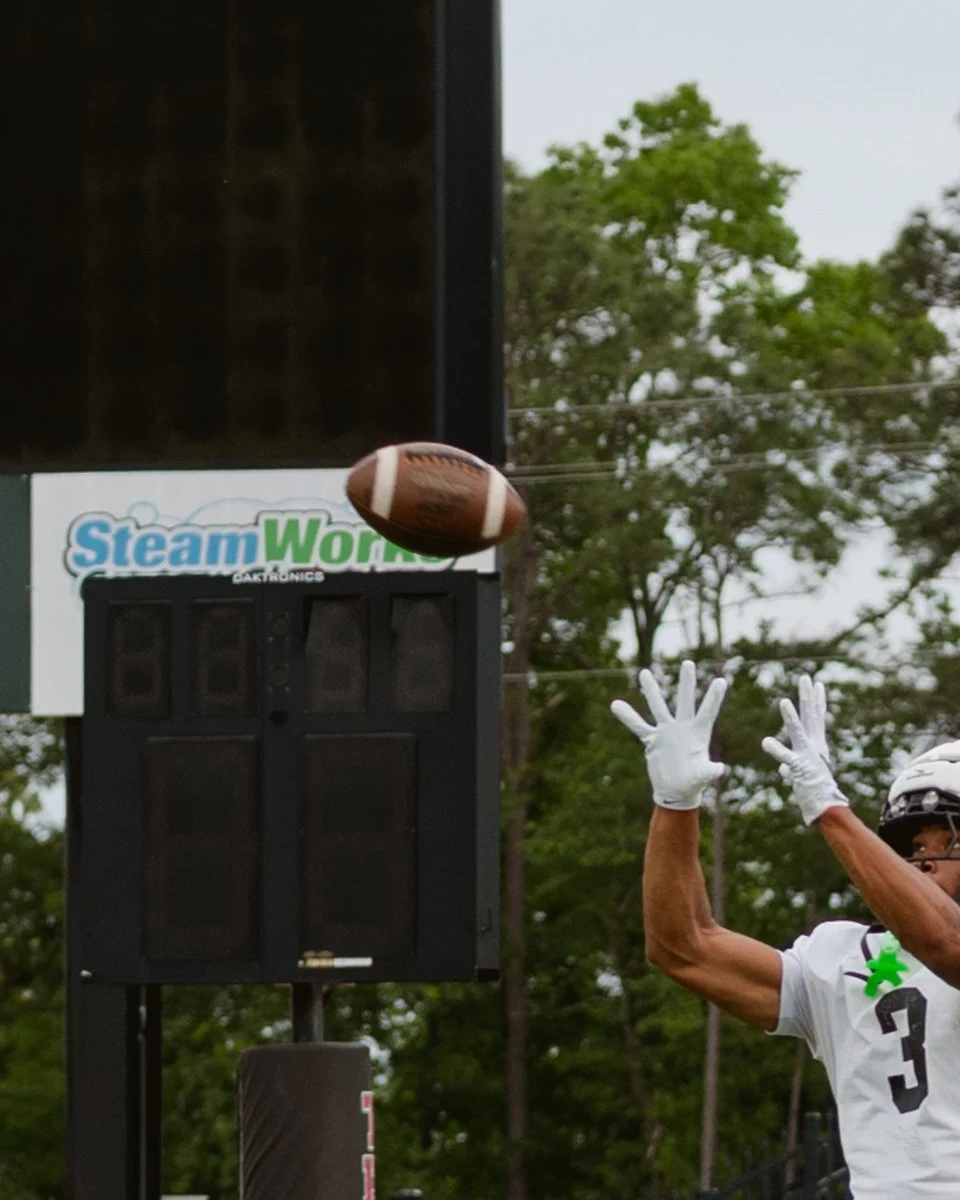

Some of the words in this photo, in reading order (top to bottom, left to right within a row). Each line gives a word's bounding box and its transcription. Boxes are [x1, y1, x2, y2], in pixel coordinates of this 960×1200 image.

[72, 518, 447, 566] SteamWor
[232, 571, 325, 584] DAKTRONICS
[874, 986, 929, 1114] 3
